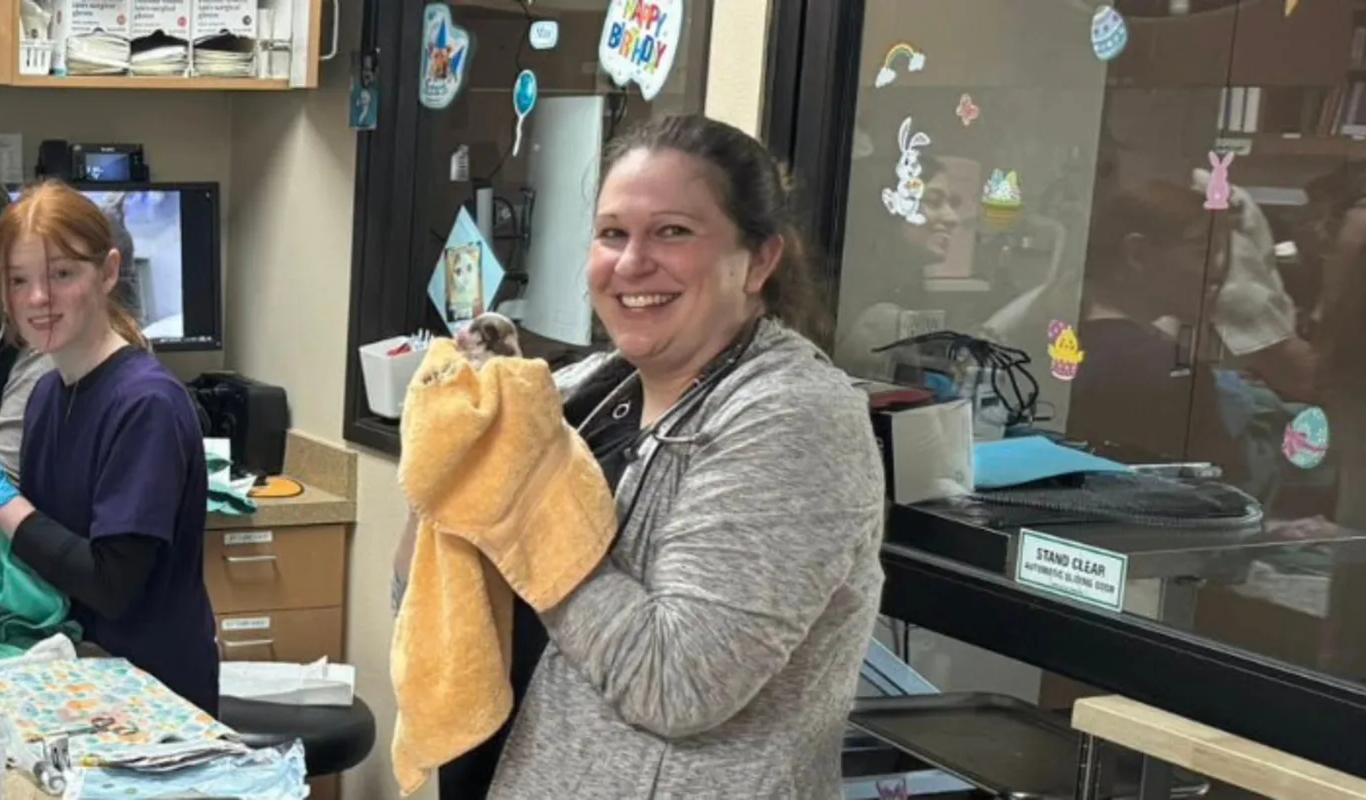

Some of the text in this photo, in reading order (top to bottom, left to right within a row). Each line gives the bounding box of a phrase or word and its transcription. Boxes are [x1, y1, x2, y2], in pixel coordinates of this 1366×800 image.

[622, 0, 667, 38] HAPPY
[608, 22, 667, 74] BIRTHDAY
[1024, 562, 1063, 579] AUTOMATIC
[1095, 581, 1115, 593] DOOR
[1037, 548, 1106, 577] STAND CLEAR
